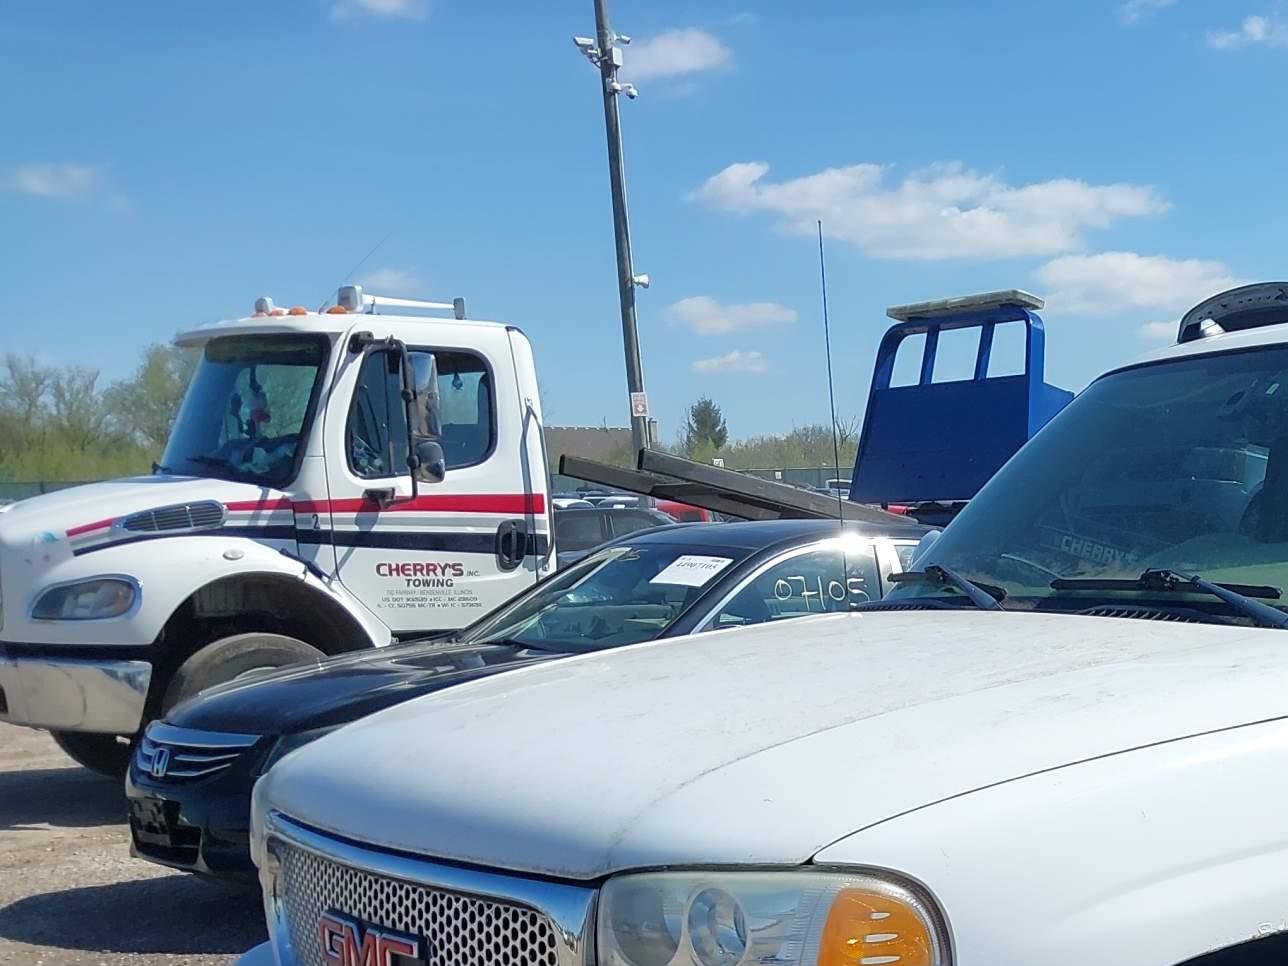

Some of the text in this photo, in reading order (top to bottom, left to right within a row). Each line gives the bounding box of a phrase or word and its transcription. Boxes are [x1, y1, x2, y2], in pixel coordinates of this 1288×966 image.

[375, 562, 464, 577] CHERRY'S
[405, 578, 454, 588] TOWING
[774, 575, 870, 612] 07105
